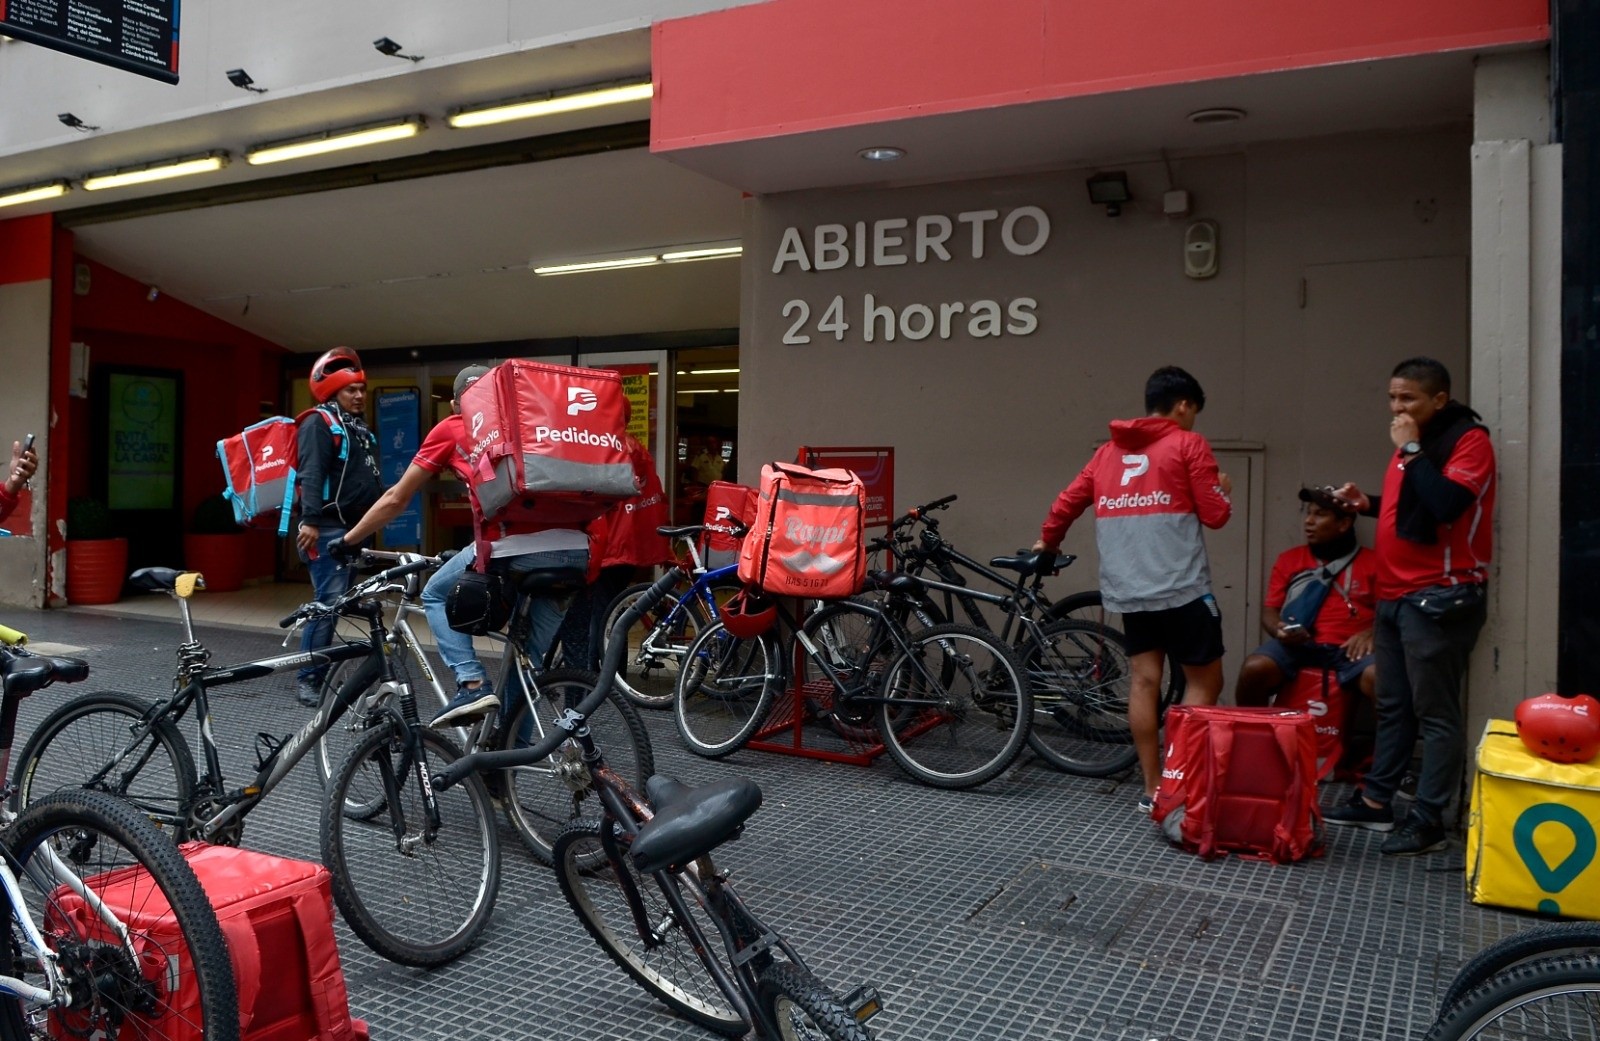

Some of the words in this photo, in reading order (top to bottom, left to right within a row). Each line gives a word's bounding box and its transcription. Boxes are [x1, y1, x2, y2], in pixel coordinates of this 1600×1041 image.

[772, 205, 1050, 274] ABIERTO
[782, 295, 849, 344] 24
[864, 293, 1038, 342] horas
[535, 427, 623, 452] PedidosYa
[255, 458, 287, 473] PedidosYa
[1097, 490, 1171, 510] PedidosYa
[784, 515, 849, 551] Rappi
